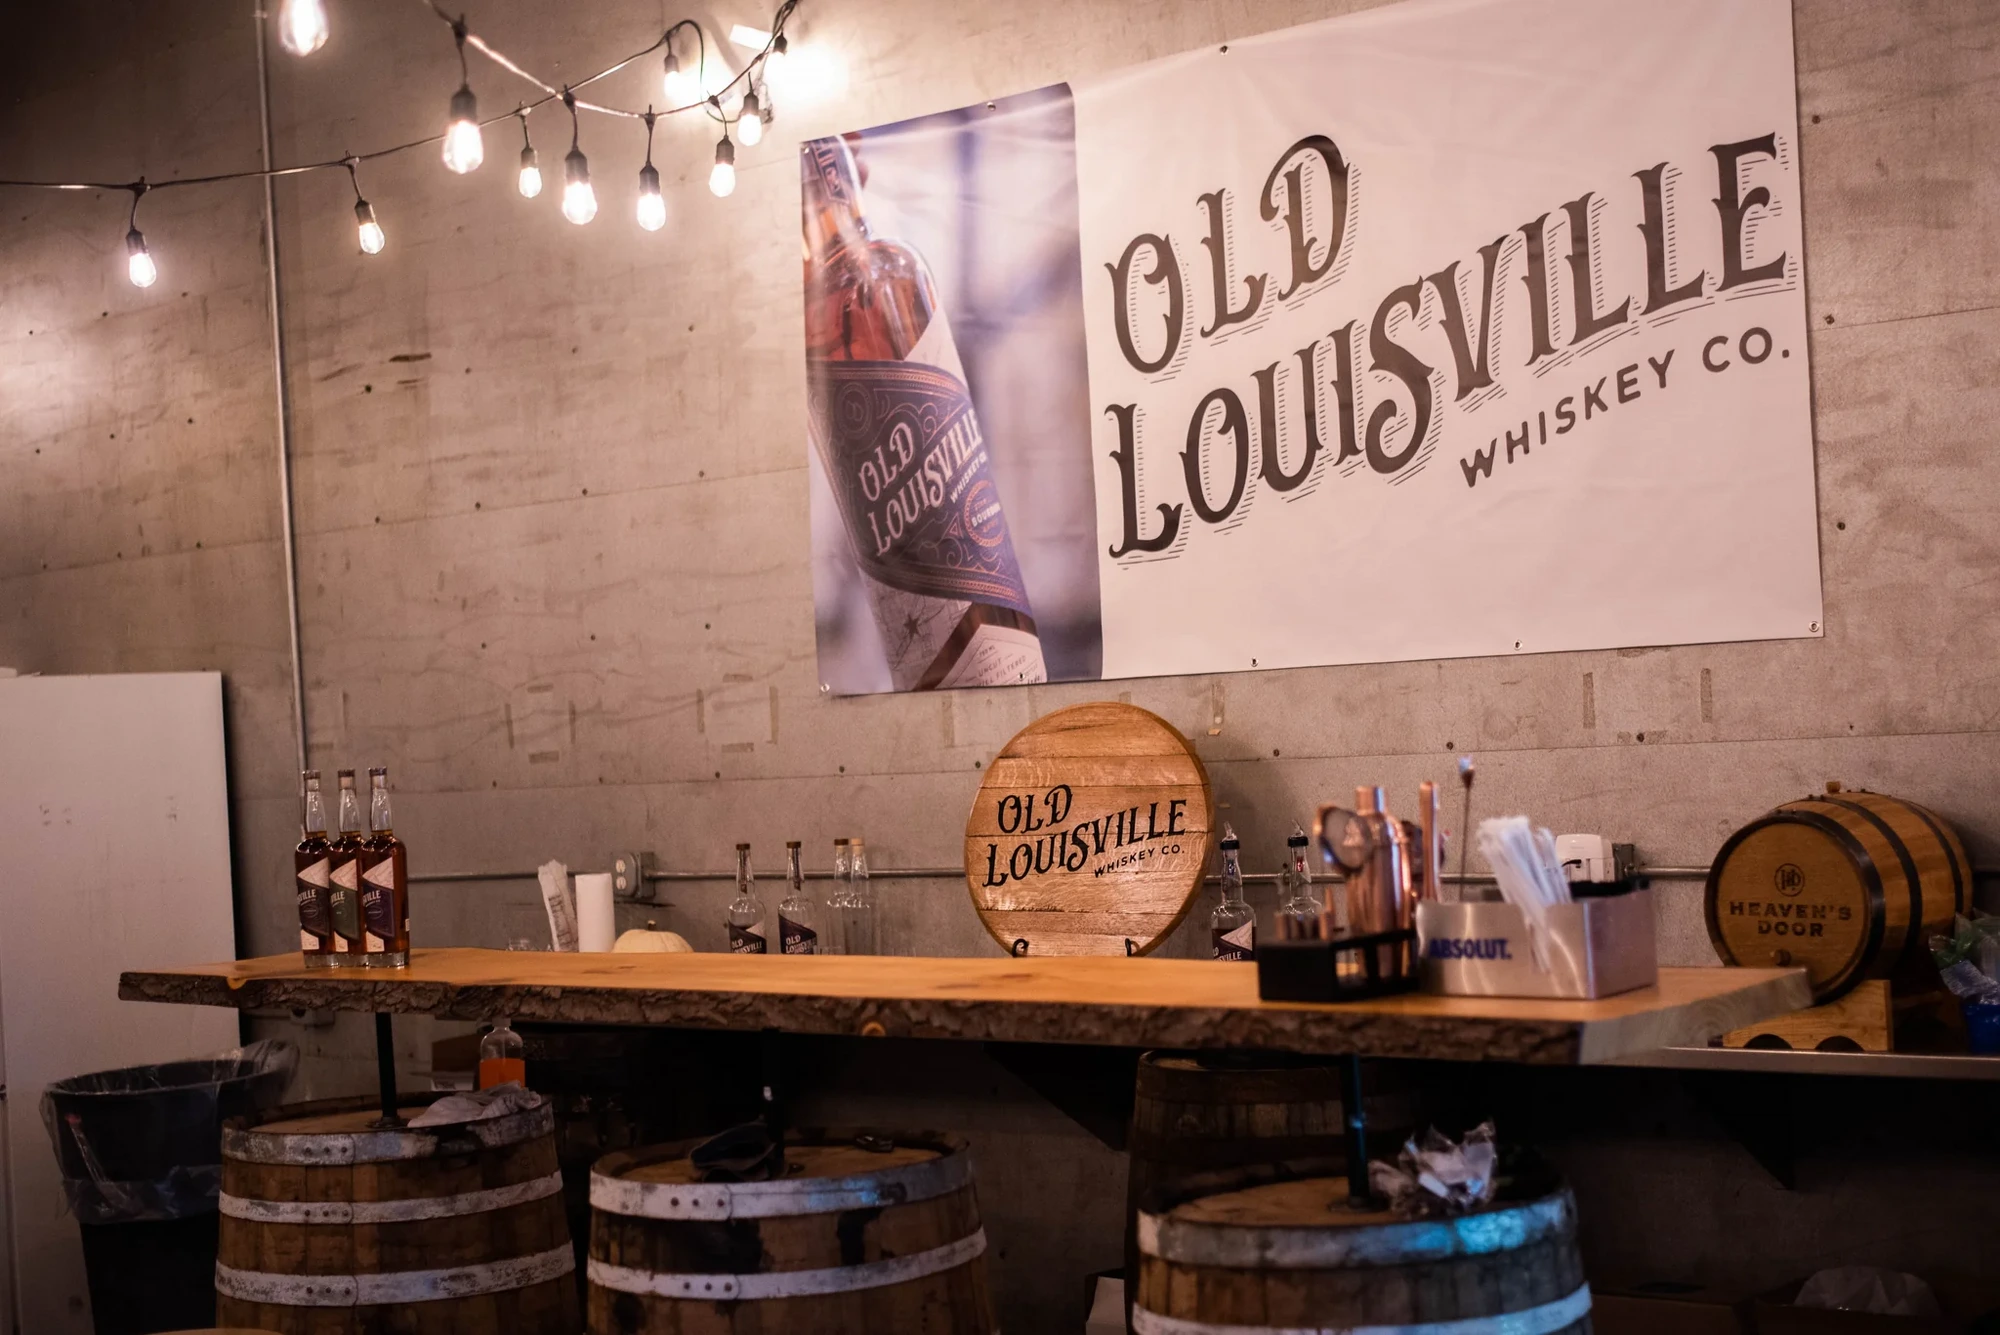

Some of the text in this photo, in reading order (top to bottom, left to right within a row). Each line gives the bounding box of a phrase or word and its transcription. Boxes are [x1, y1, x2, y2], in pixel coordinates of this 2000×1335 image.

[1103, 134, 1357, 379] OLD
[1103, 131, 1793, 564] LOUISVILLE
[1459, 326, 1790, 488] WHISKEY CO.
[858, 422, 914, 501] OLD
[950, 457, 980, 504] WHISKEY
[997, 784, 1073, 834] OLD
[982, 799, 1187, 888] LOUISVILLE
[1094, 844, 1185, 878] WHISKEY CO.
[1729, 901, 1853, 920] HEAVEN'S
[1757, 920, 1824, 937] DOOR
[785, 935, 801, 946] OLD
